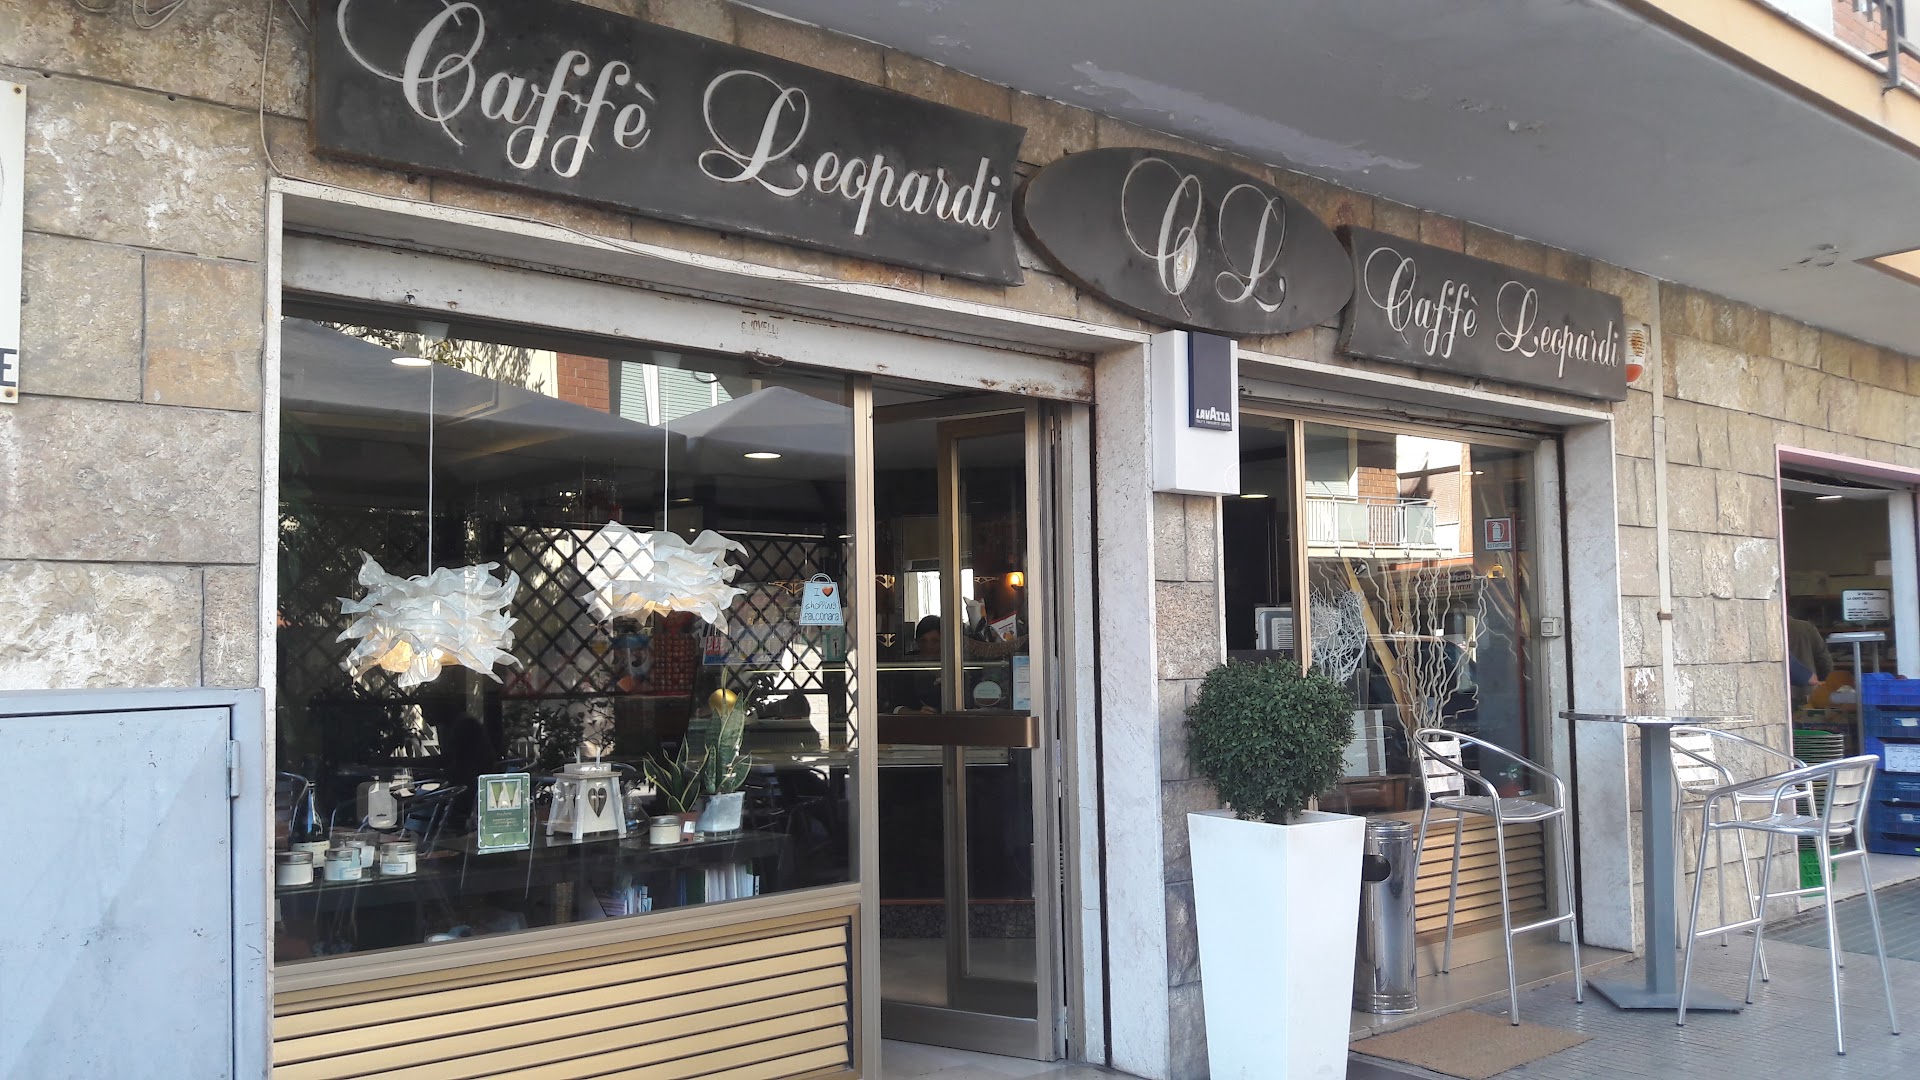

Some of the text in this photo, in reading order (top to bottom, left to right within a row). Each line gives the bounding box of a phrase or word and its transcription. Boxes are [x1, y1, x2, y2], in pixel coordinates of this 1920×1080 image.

[337, 0, 1001, 236] Caffè Leopardi
[1364, 247, 1620, 378] Caffè Leopardi
[1196, 406, 1231, 422] LAVAZZA
